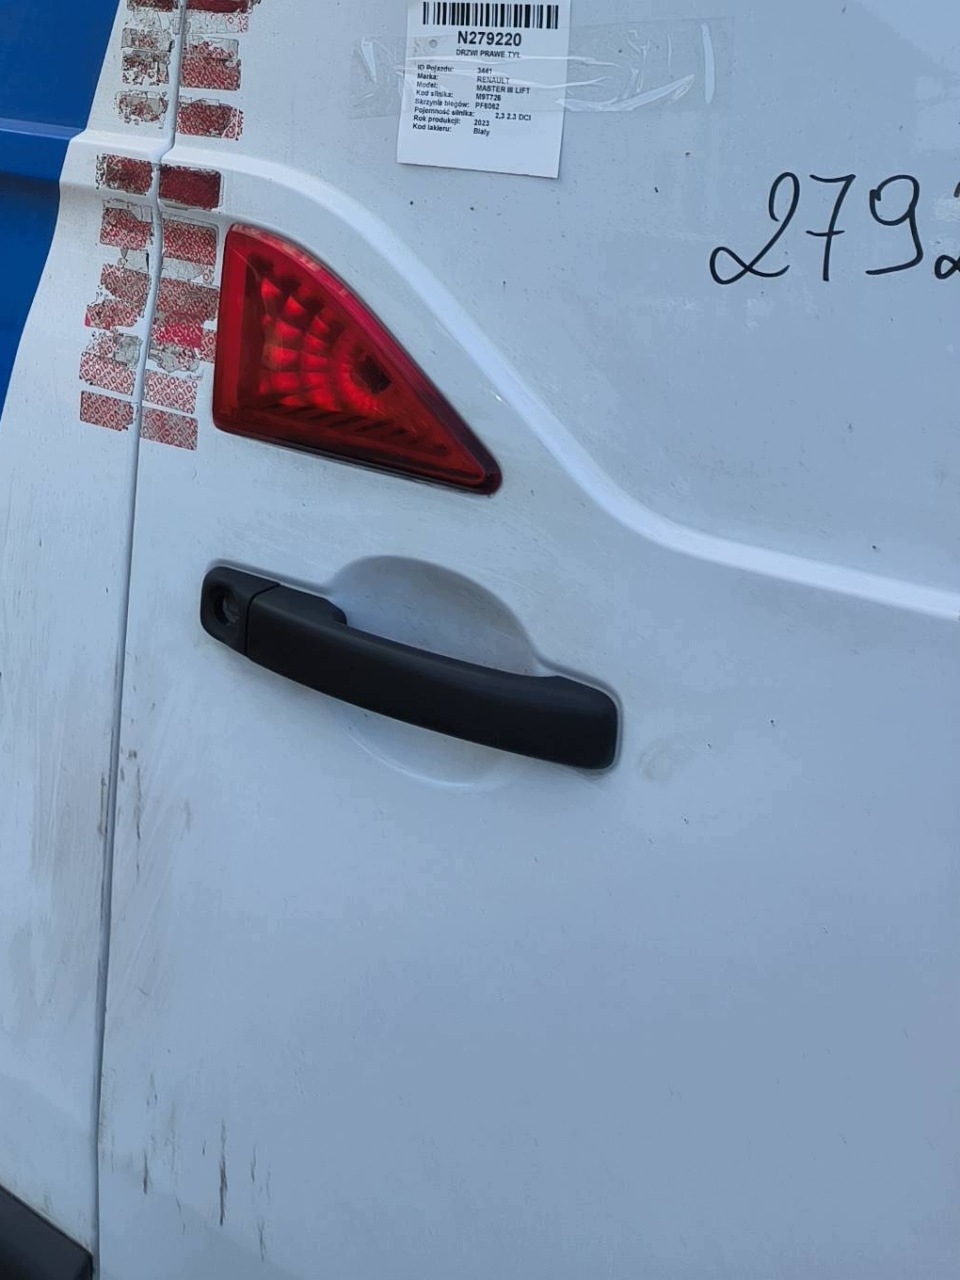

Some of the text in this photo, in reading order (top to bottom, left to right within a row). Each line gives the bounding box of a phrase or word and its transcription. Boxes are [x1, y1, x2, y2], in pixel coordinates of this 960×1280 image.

[457, 30, 522, 47] N279220
[480, 50, 505, 58] PRAWE
[477, 76, 510, 84] RENAULT
[417, 81, 438, 89] Model:
[476, 85, 506, 93] MASTER
[515, 87, 530, 95] LIFT
